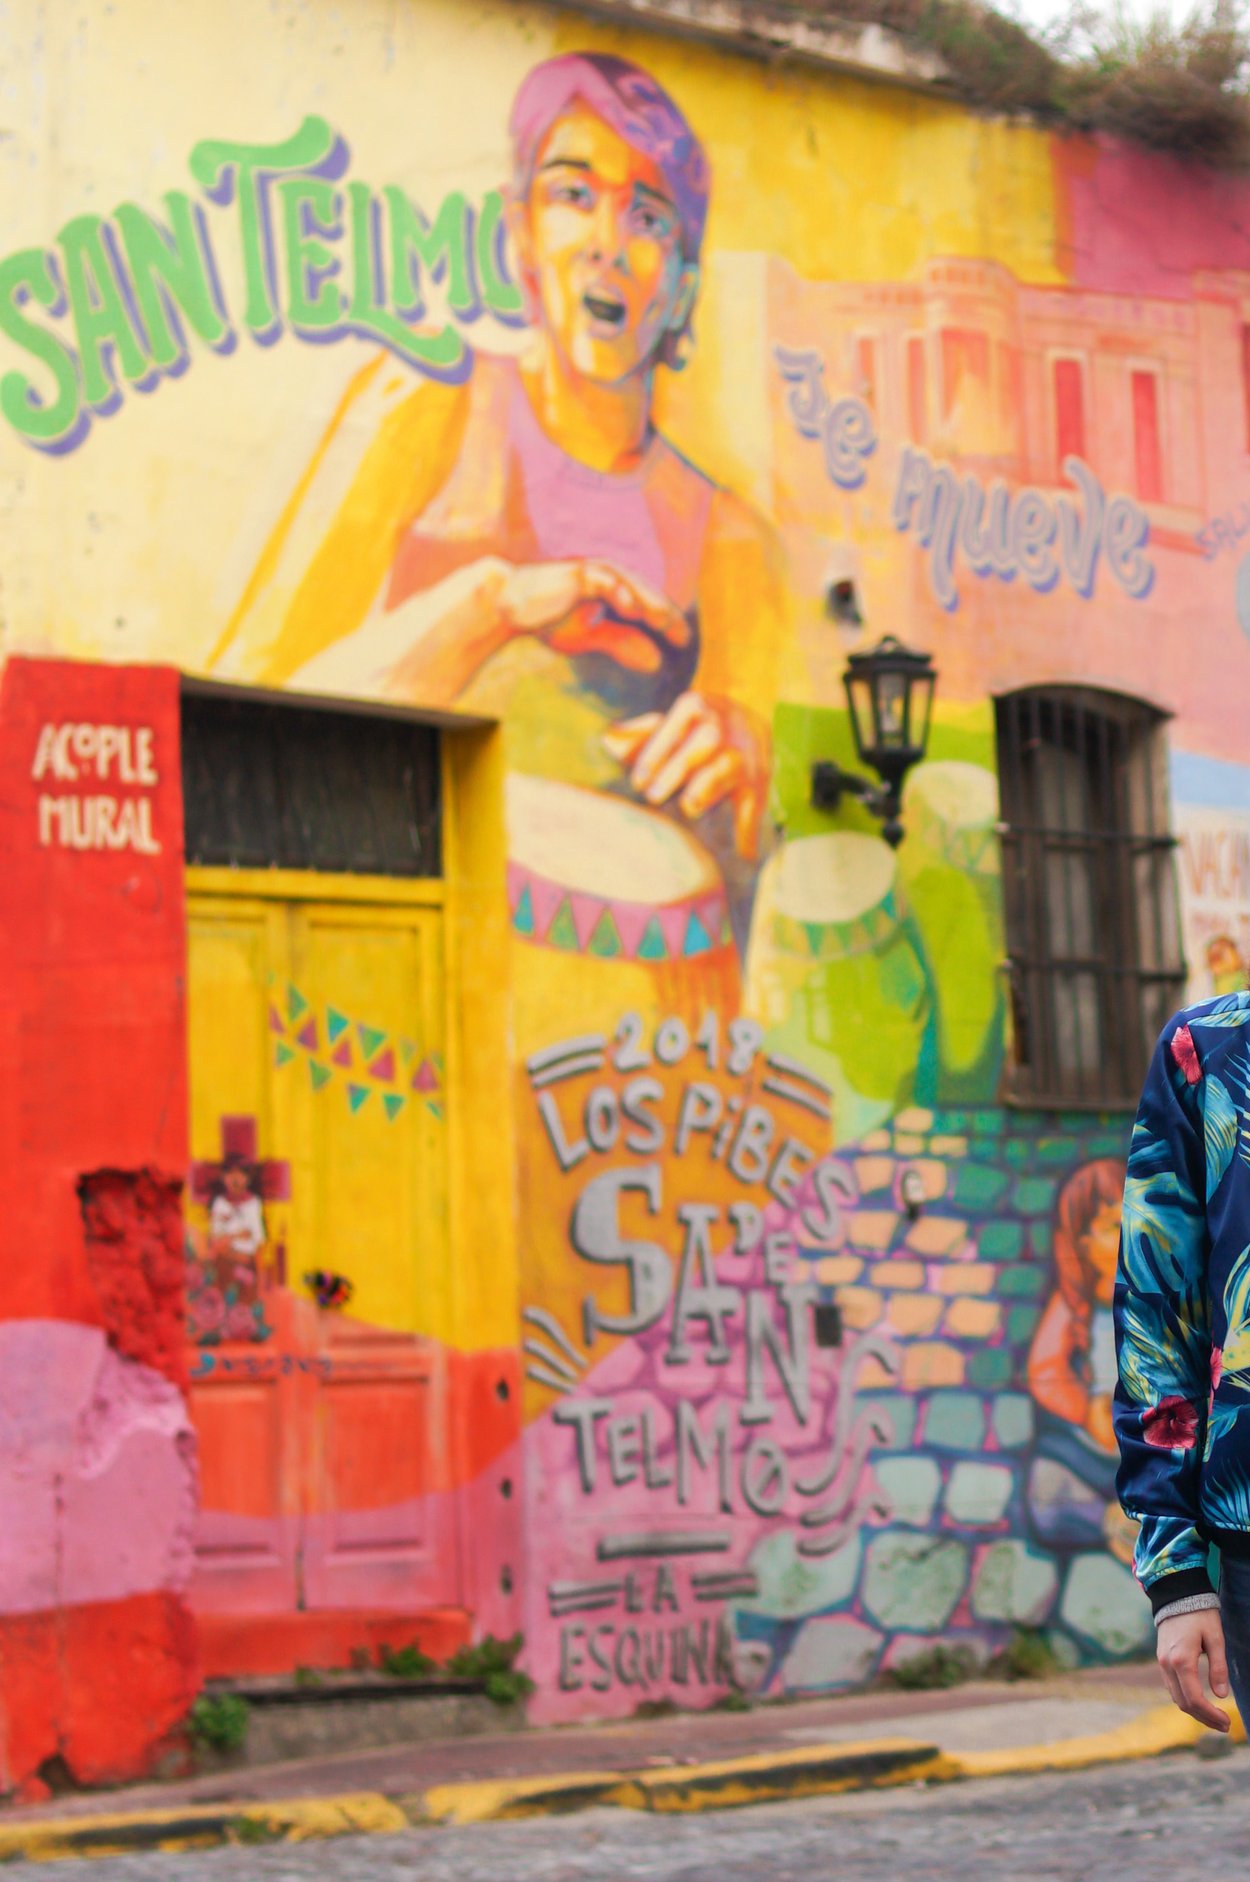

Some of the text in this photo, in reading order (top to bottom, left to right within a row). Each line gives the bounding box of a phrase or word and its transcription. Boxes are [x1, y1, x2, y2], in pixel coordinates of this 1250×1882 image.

[0, 188, 238, 456] SAN
[31, 722, 158, 787] ACOPLE
[38, 793, 162, 855] MURAL
[613, 1011, 764, 1076] 2018
[537, 1077, 666, 1173] LOS
[569, 1161, 820, 1427] SAN
[553, 1395, 789, 1517] TELMO
